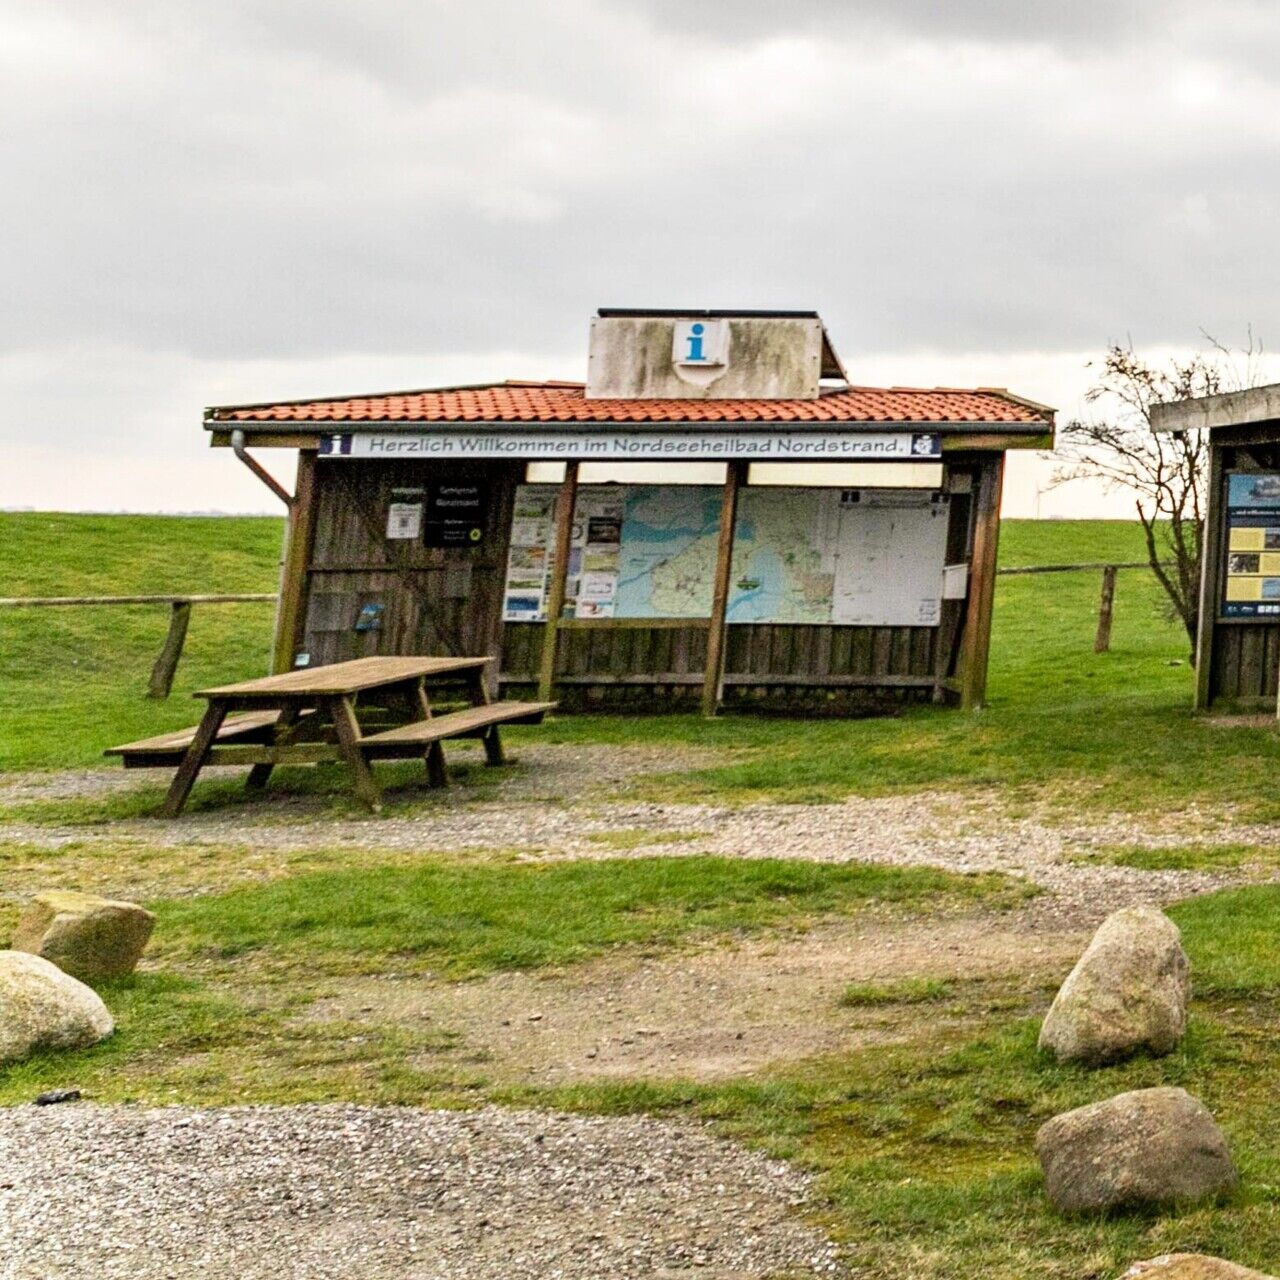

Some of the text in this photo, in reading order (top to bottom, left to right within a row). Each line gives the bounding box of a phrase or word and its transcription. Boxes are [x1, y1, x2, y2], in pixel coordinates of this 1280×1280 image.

[369, 437, 904, 453] Herzlich Willkommen im Nordseeheilbad Nordstrand.
